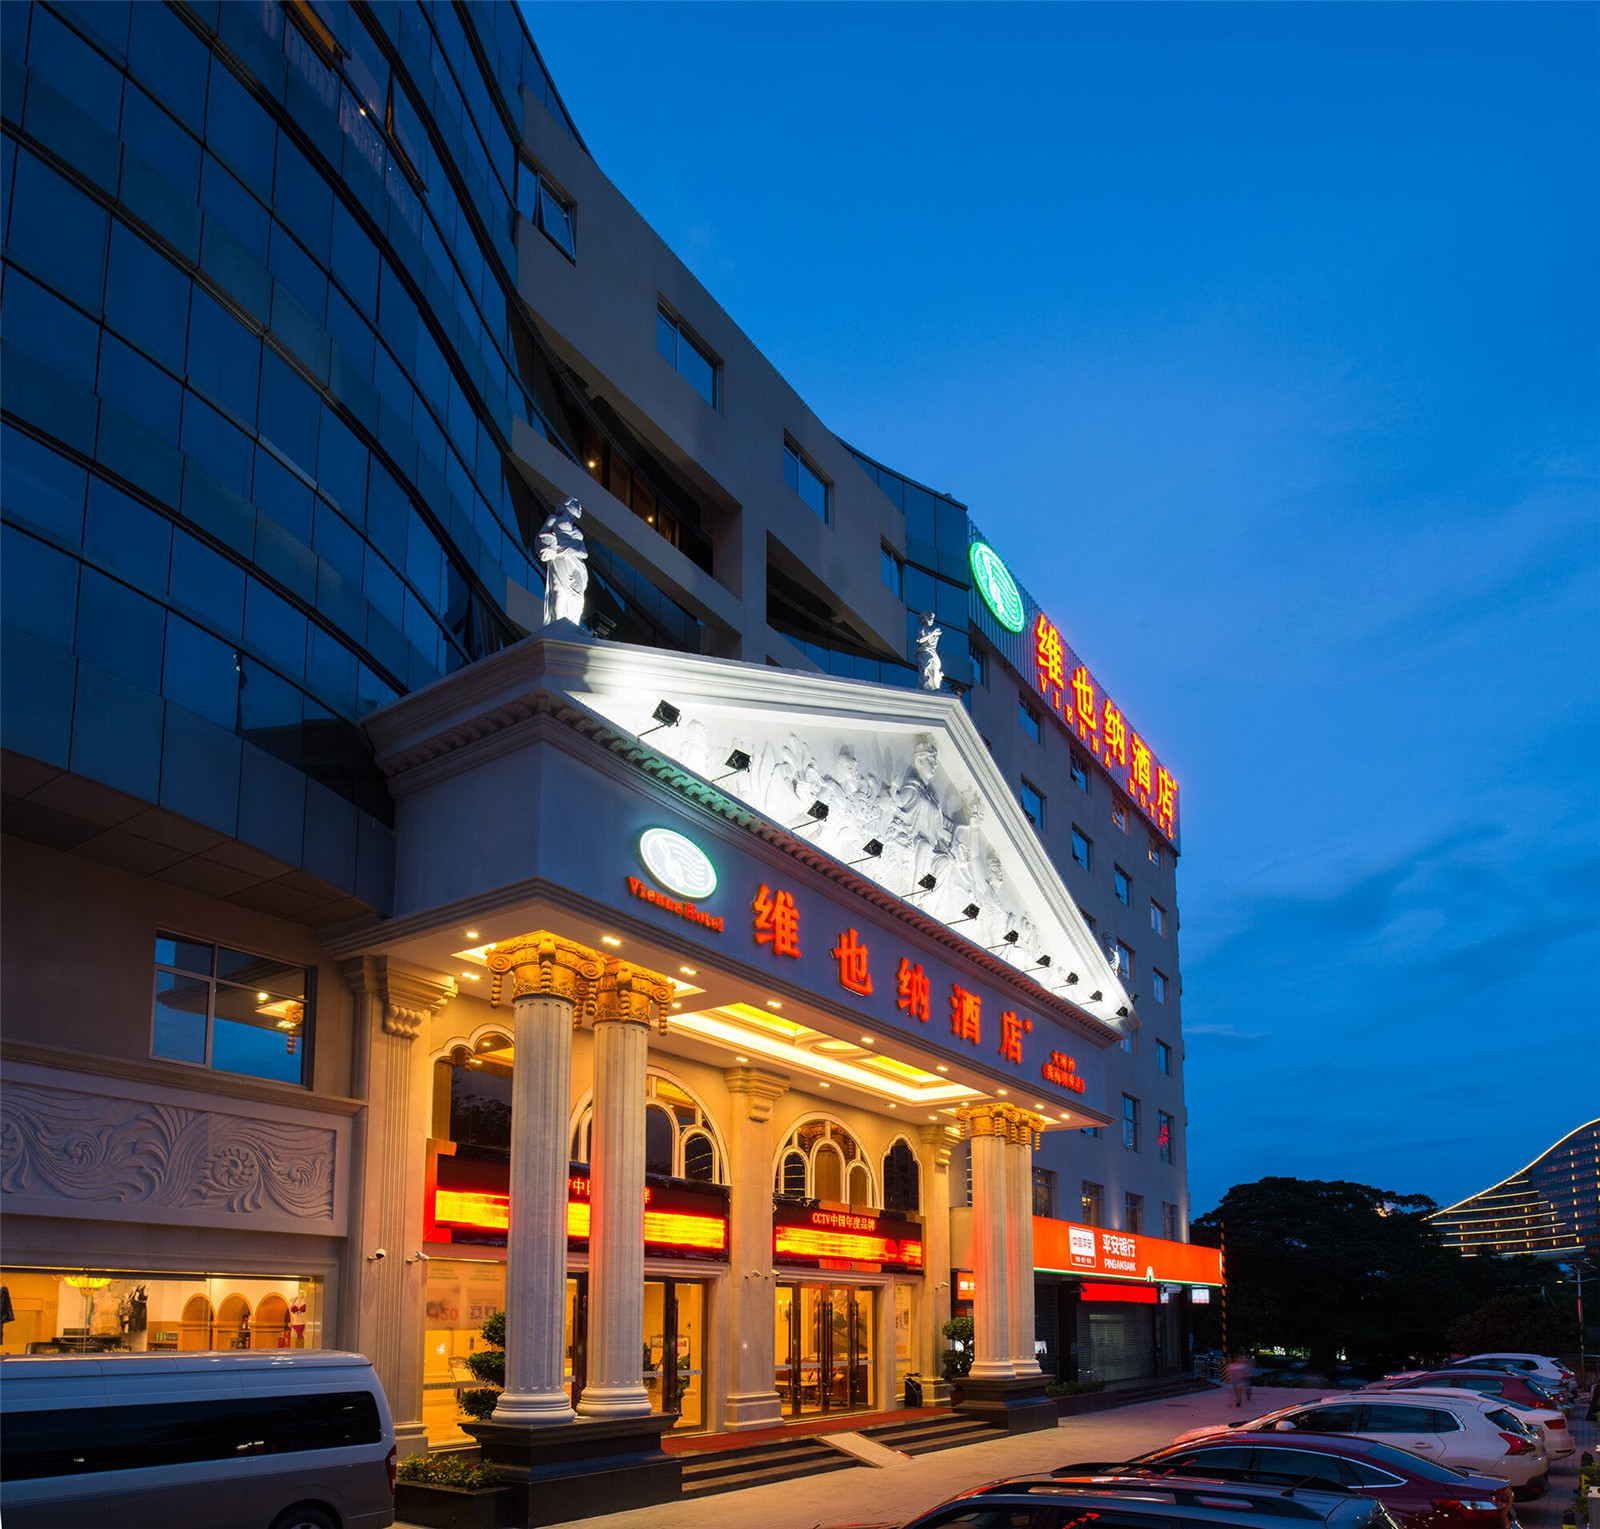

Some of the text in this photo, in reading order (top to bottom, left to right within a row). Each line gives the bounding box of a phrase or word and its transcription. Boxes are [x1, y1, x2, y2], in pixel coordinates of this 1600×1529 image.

[1036, 613, 1174, 823] 维也纳酒店
[1039, 672, 1174, 840] VIENNA HOTEL
[627, 875, 724, 933] Vienna Hotel
[751, 882, 1023, 1064] 维也纳酒店
[812, 1212, 876, 1231] CCTV中国年度品牌
[1102, 1233, 1136, 1258] 平安银行
